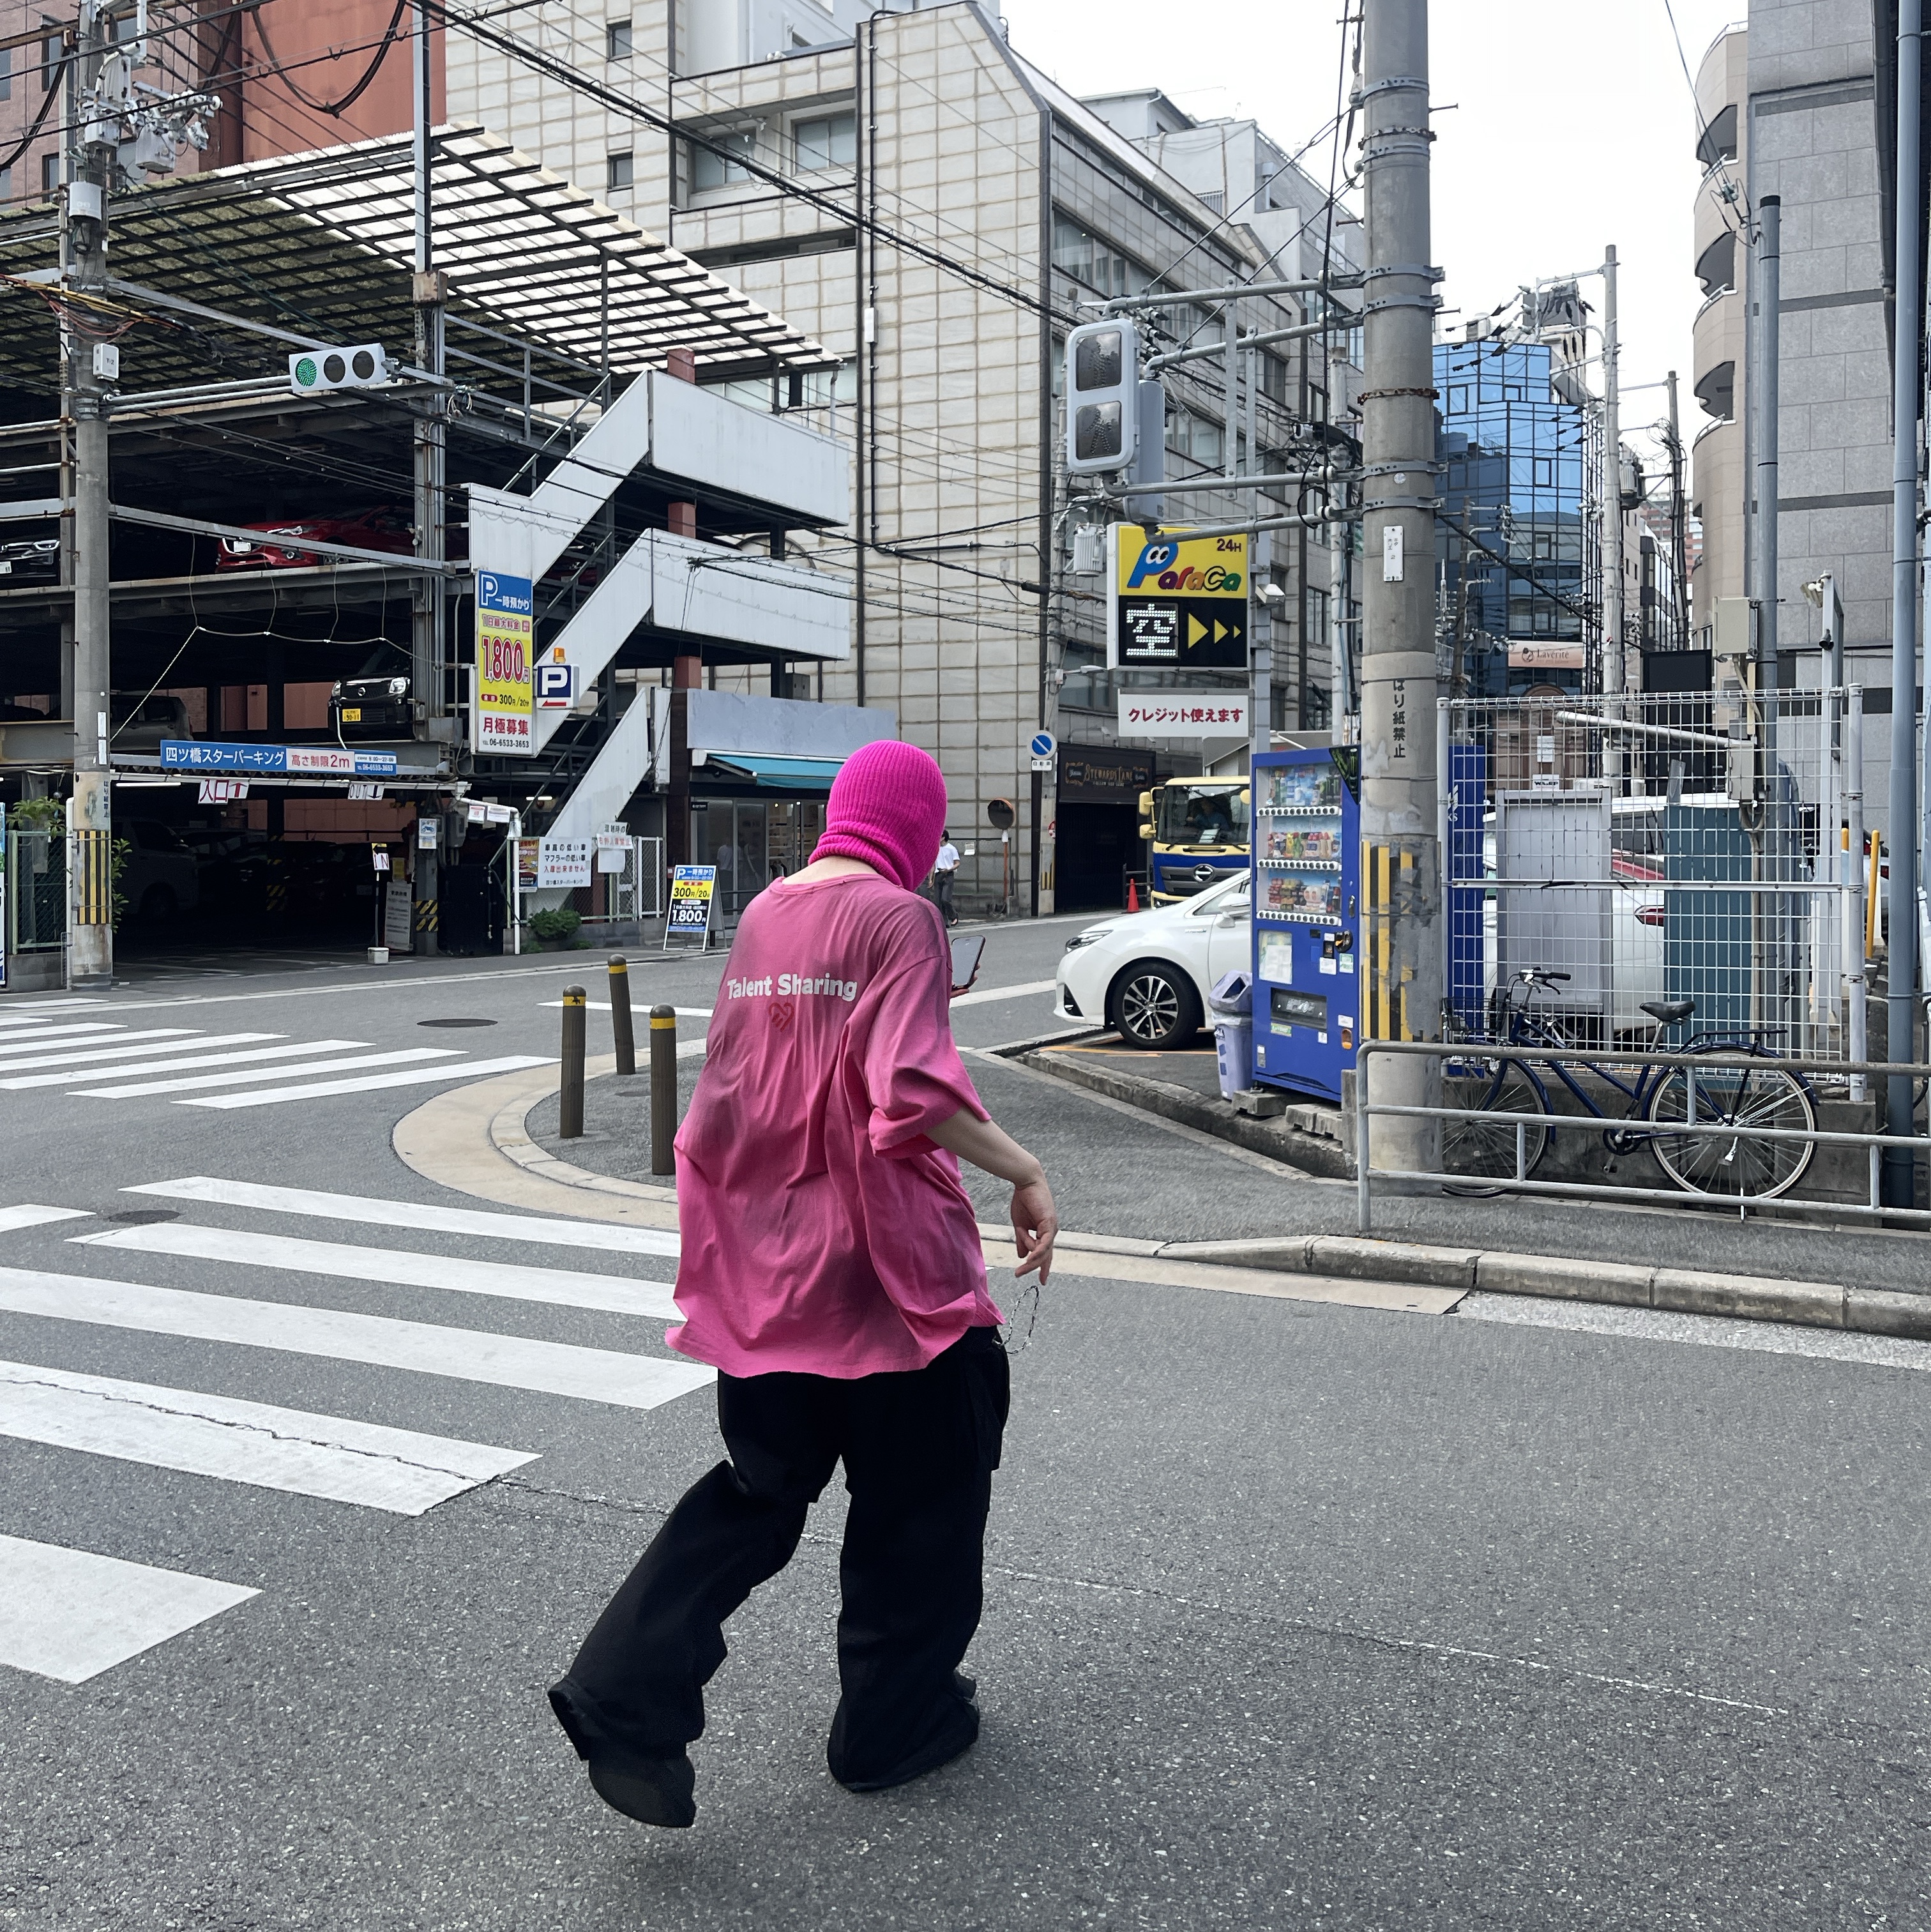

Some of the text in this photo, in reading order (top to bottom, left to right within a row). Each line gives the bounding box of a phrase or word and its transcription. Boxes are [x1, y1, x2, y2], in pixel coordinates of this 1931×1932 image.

[1216, 538, 1241, 552] 24H
[1127, 542, 1241, 591] ParaCa
[481, 574, 531, 611] P 一時預かり
[1126, 604, 1176, 656] 空
[541, 667, 568, 695] P
[1128, 708, 1243, 722] クレジット使えます
[1393, 679, 1405, 758] はり紙禁止
[483, 717, 529, 735] 月極募集
[489, 738, 529, 748] 06-6533-3653
[165, 747, 285, 765] 四ツ橋スターパーキング
[292, 754, 350, 768] 高さ制限2m
[199, 779, 229, 802] 入口
[349, 784, 368, 798] OUT
[545, 844, 586, 852] 車高の低い車
[374, 854, 389, 869] IN
[677, 869, 686, 879] P
[727, 973, 858, 1001] Talent Sharing
